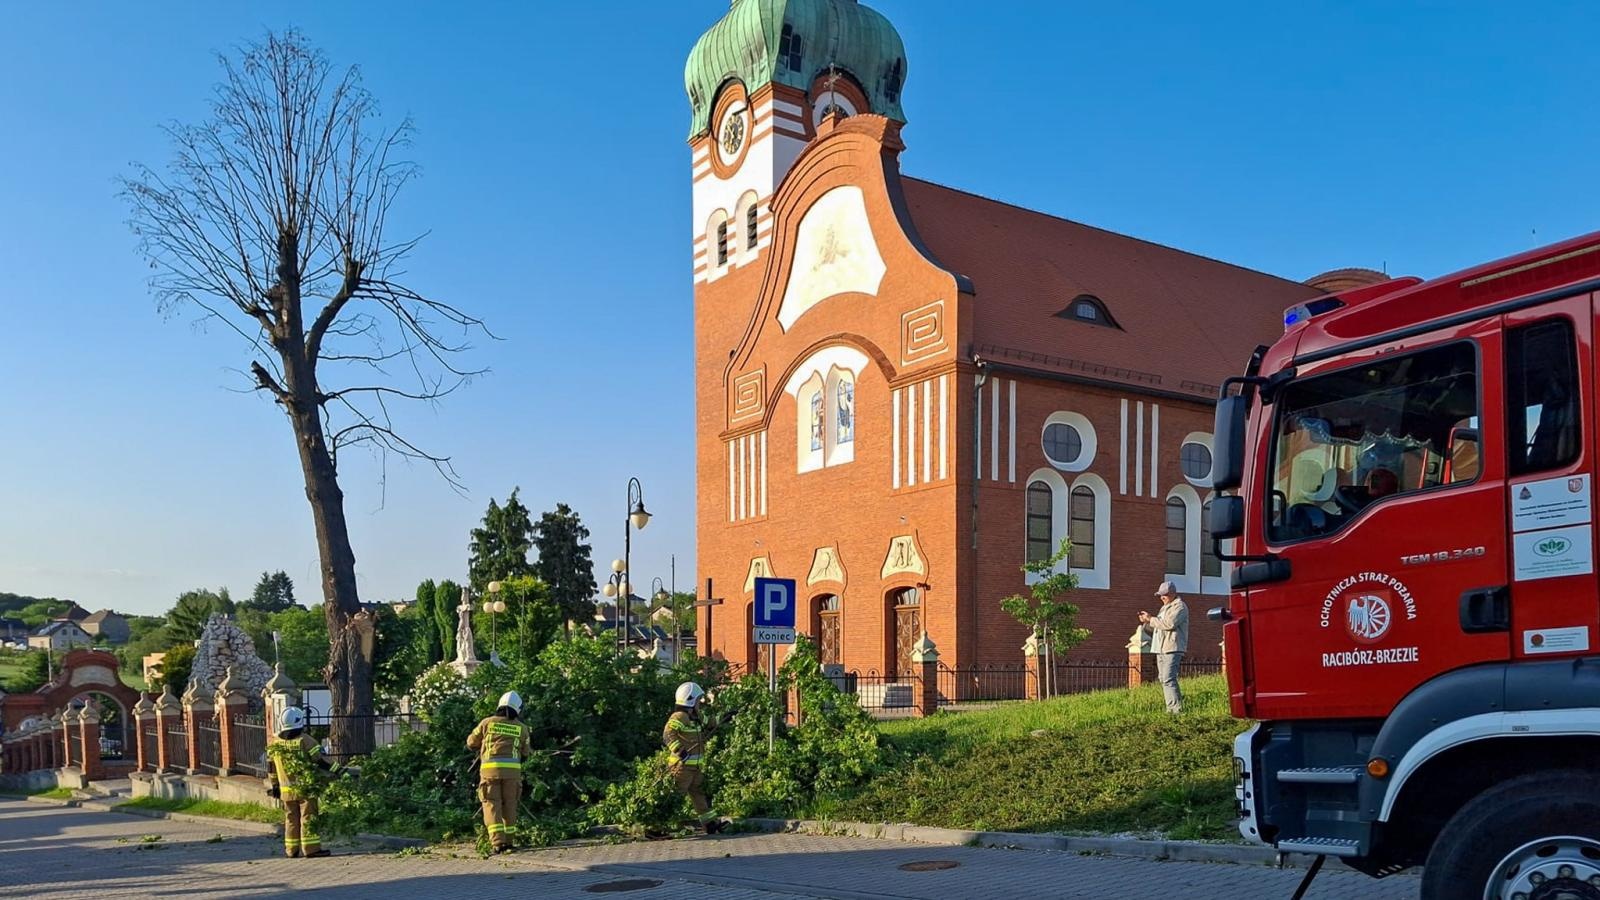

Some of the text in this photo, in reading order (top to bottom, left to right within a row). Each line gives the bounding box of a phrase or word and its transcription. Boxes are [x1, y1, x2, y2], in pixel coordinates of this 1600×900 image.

[1400, 546, 1486, 565] TGM 18.340
[764, 583, 788, 621] P
[1320, 576, 1357, 627] OCHOTNICZA
[759, 631, 790, 641] Koniec
[1322, 647, 1419, 667] RACIBÓRZ-BRZEZIE
